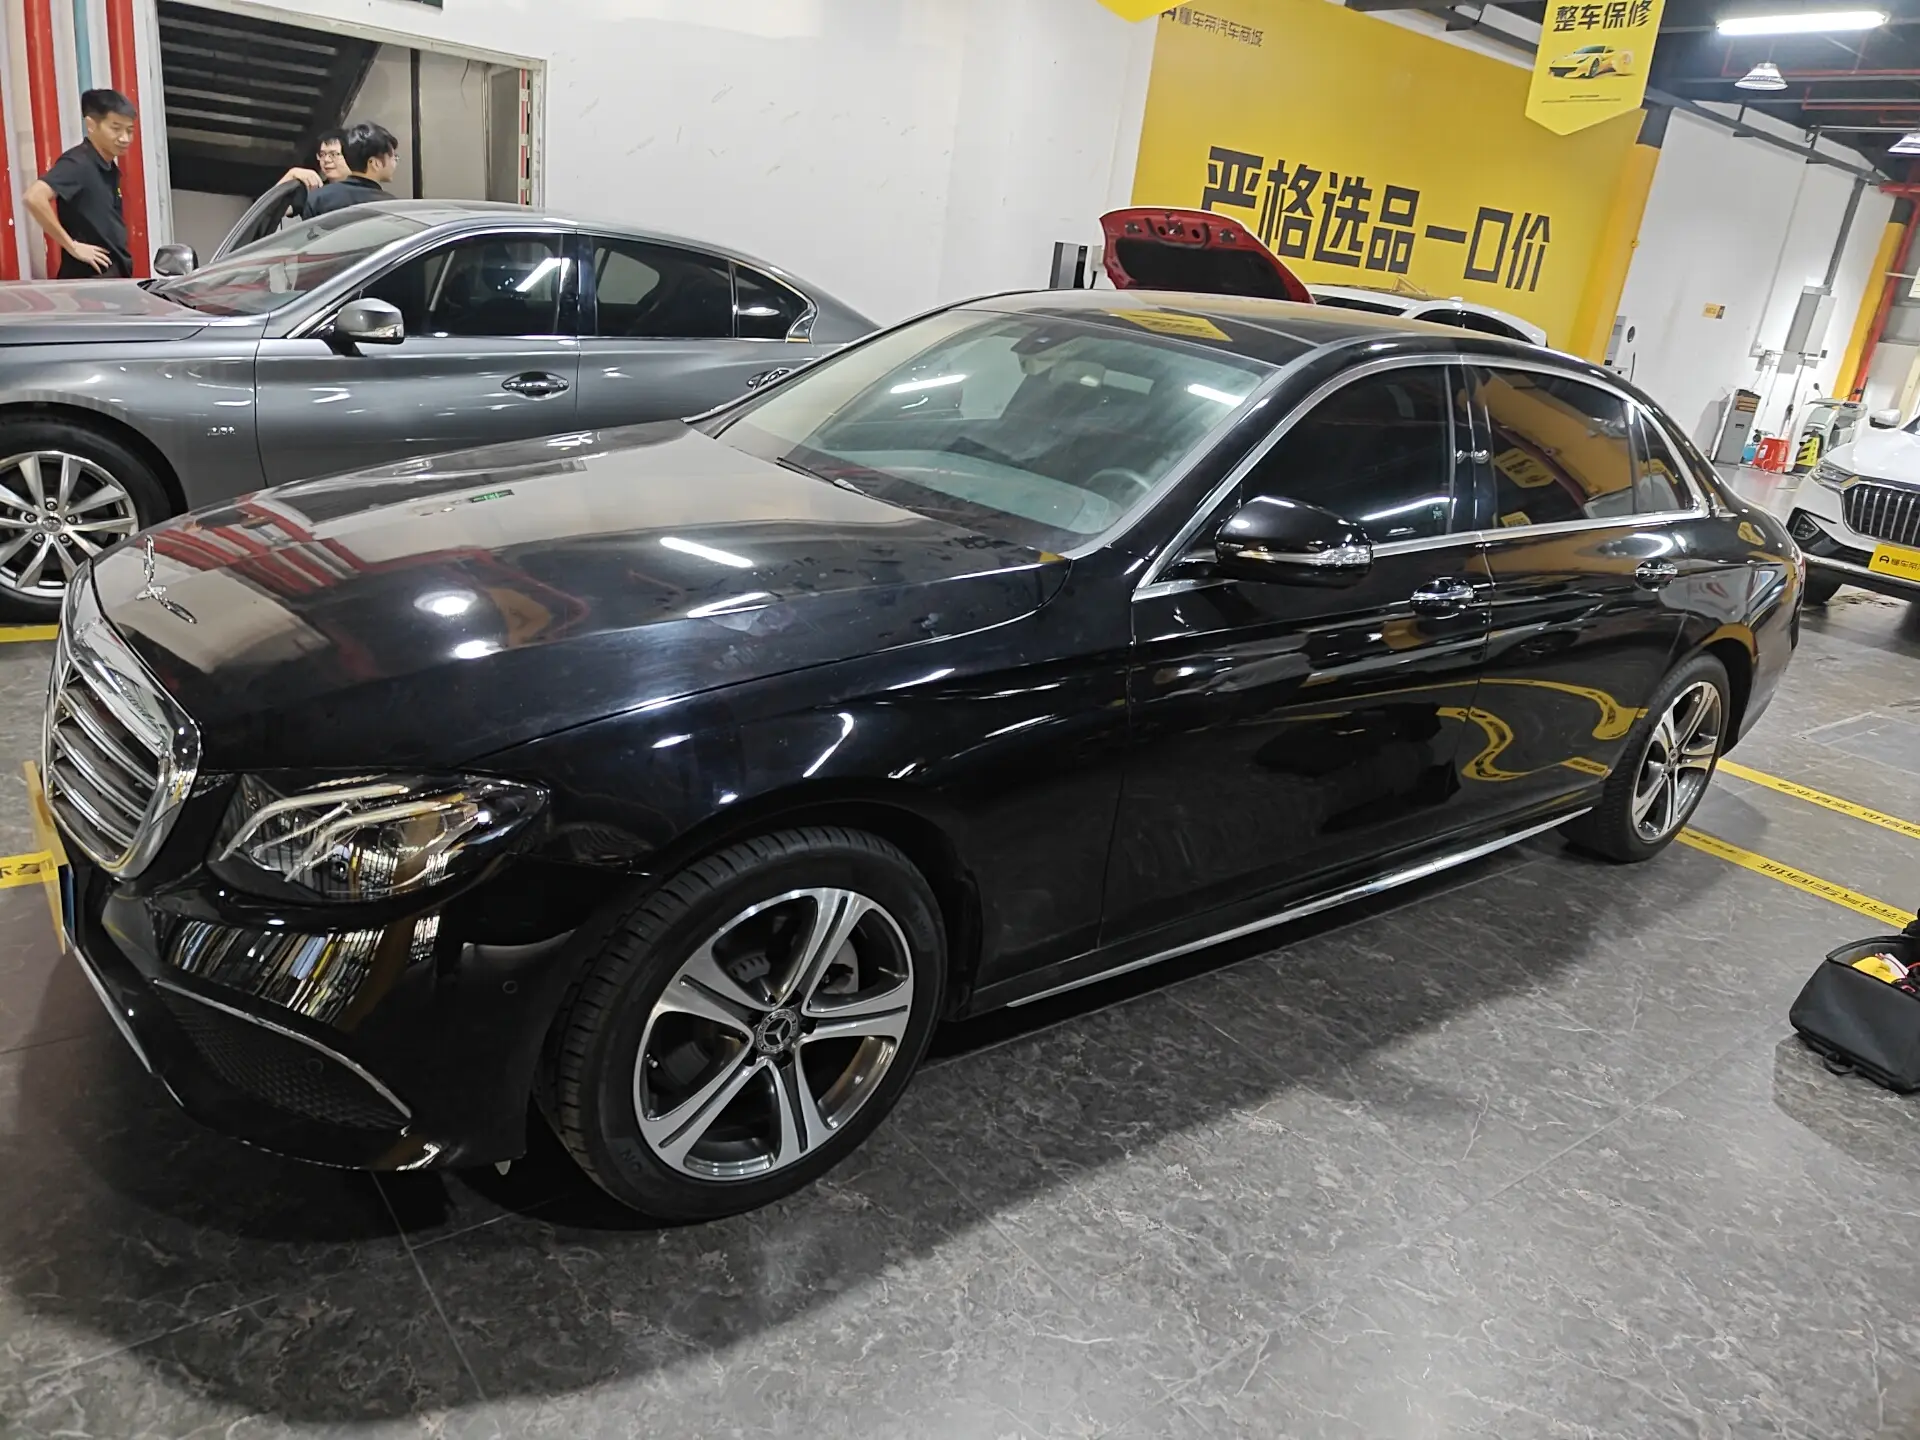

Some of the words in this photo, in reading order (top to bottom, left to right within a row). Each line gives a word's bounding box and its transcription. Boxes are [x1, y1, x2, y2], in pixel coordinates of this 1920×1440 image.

[1553, 0, 1652, 32] 整车保修
[1201, 145, 1551, 292] 严格选品一口价
